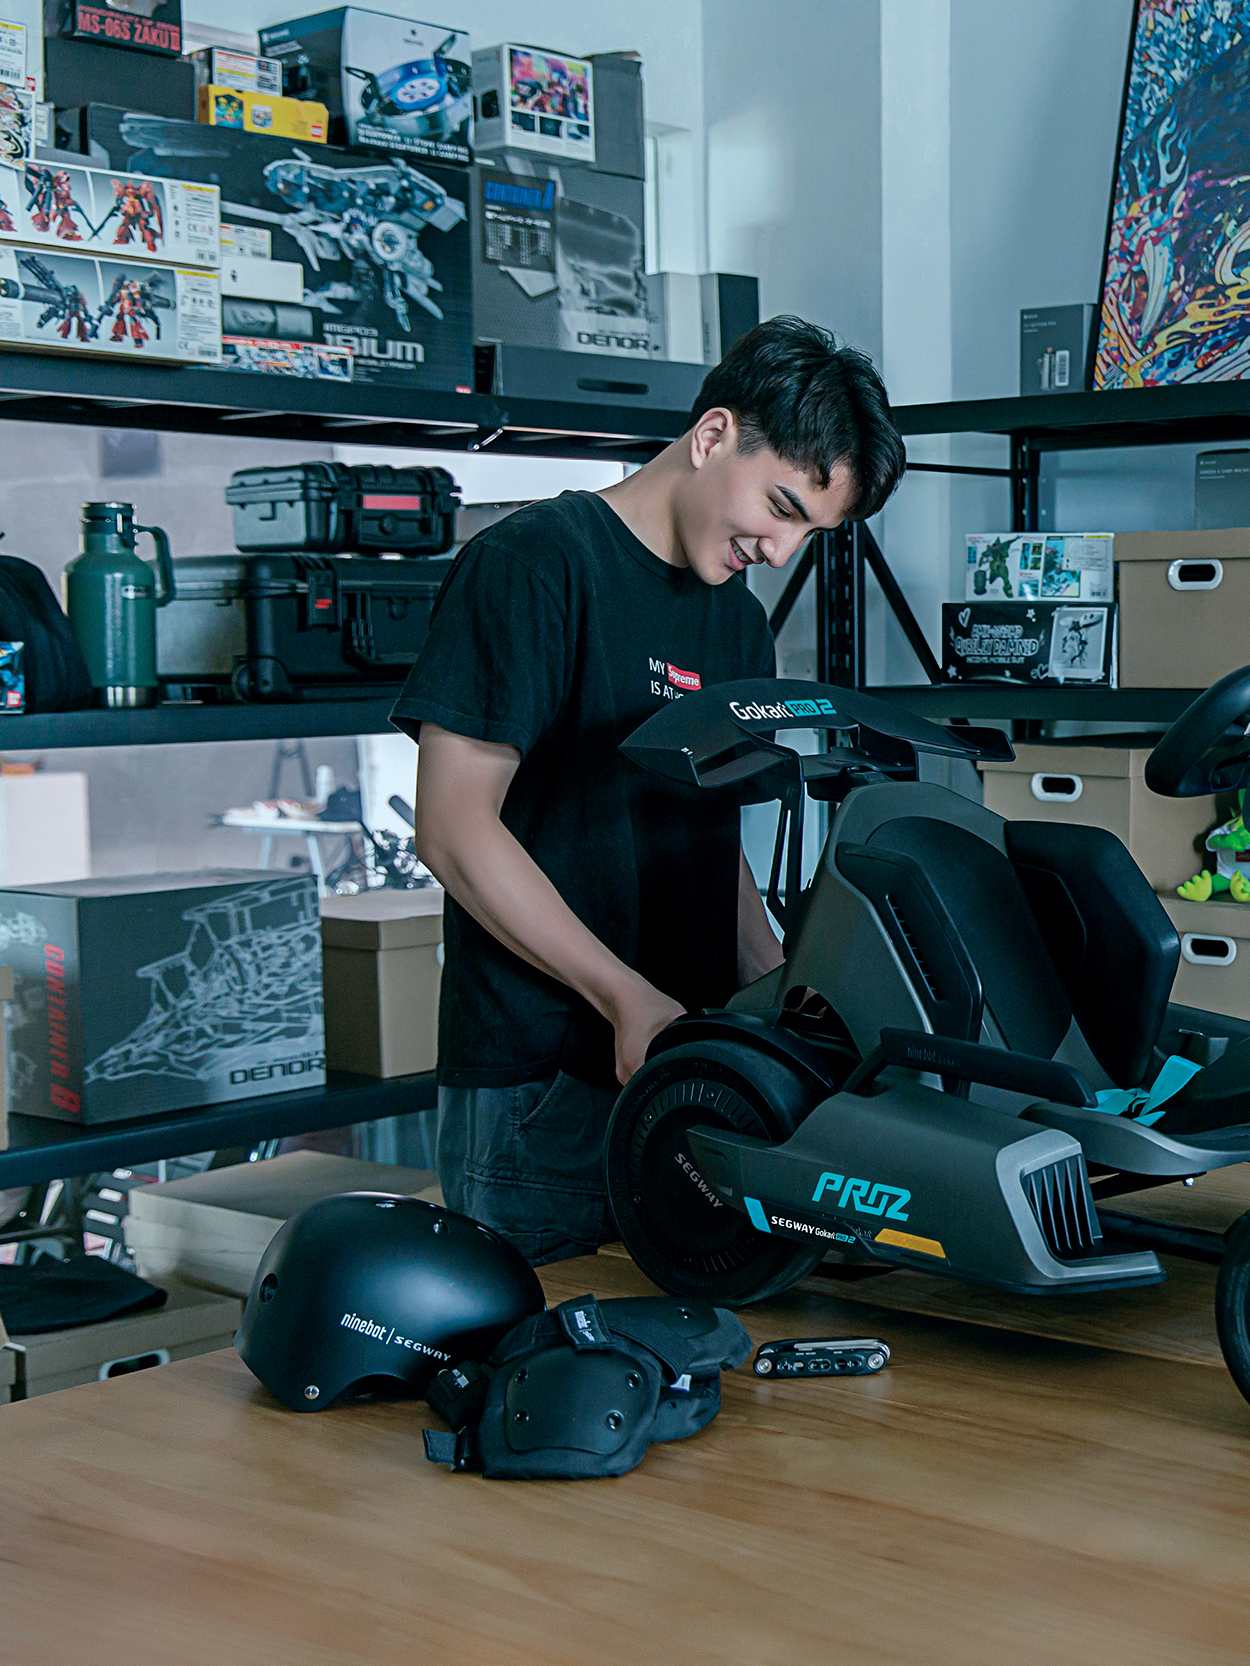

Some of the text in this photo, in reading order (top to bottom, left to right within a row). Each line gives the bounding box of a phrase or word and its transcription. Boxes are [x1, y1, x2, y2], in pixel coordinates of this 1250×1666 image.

[323, 333, 425, 363] BIUM
[648, 657, 699, 686] MY Supreme
[651, 680, 661, 695] IS
[729, 701, 793, 720] Gokart
[674, 1153, 723, 1208] SEGWAY
[771, 1216, 815, 1234] SEGWAY
[341, 1313, 451, 1361] ninebot SEGWAY
